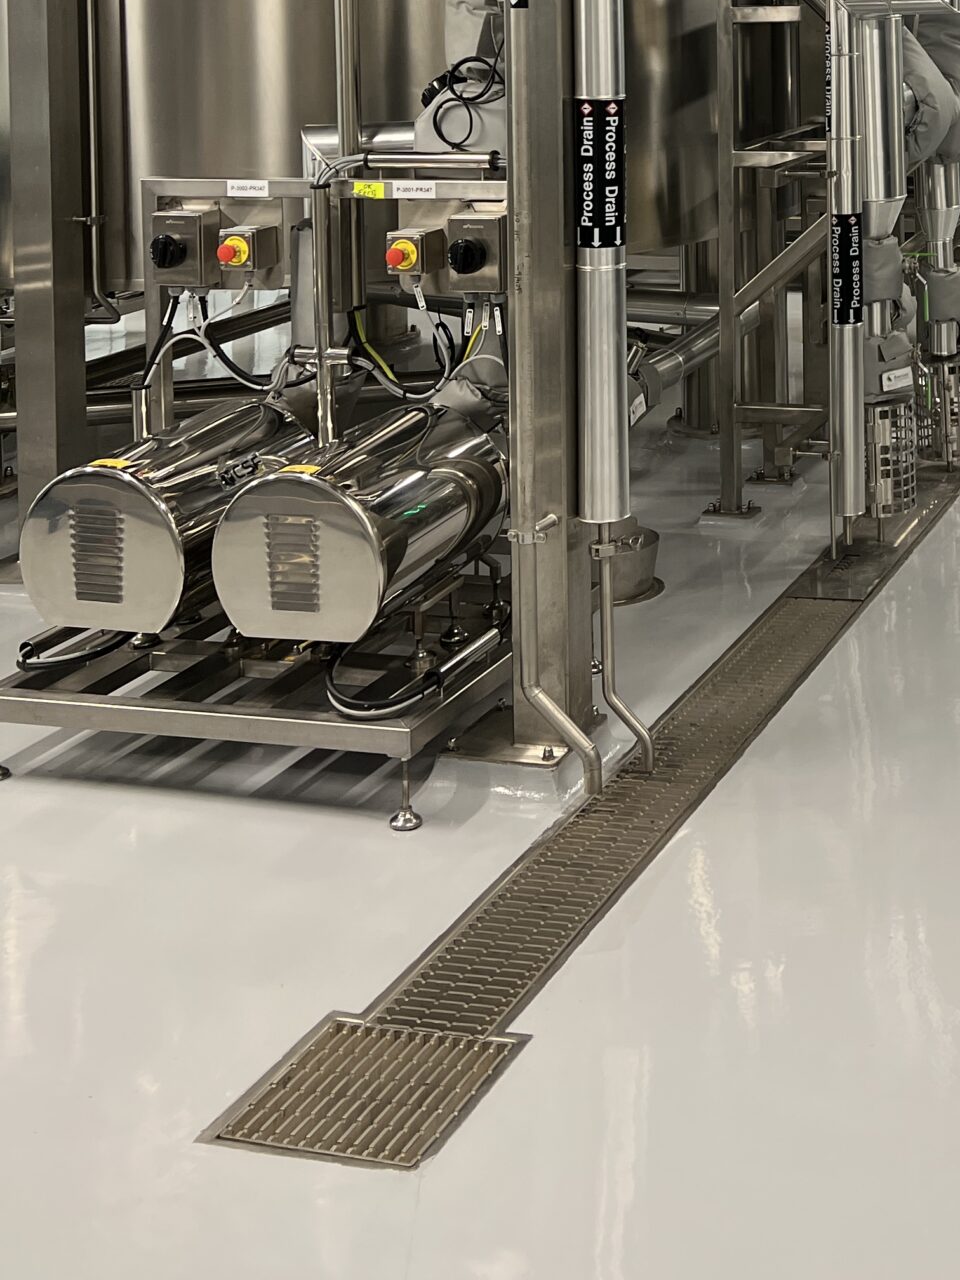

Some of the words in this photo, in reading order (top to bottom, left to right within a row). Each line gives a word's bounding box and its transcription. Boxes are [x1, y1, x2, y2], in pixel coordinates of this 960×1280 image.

[581, 116, 594, 156] Drain
[605, 116, 619, 179] Process
[581, 163, 594, 226] Process
[605, 186, 619, 226] Drain
[832, 226, 841, 274] Process
[849, 225, 859, 256] Drain
[833, 279, 843, 308] Drain
[851, 260, 860, 308] Process
